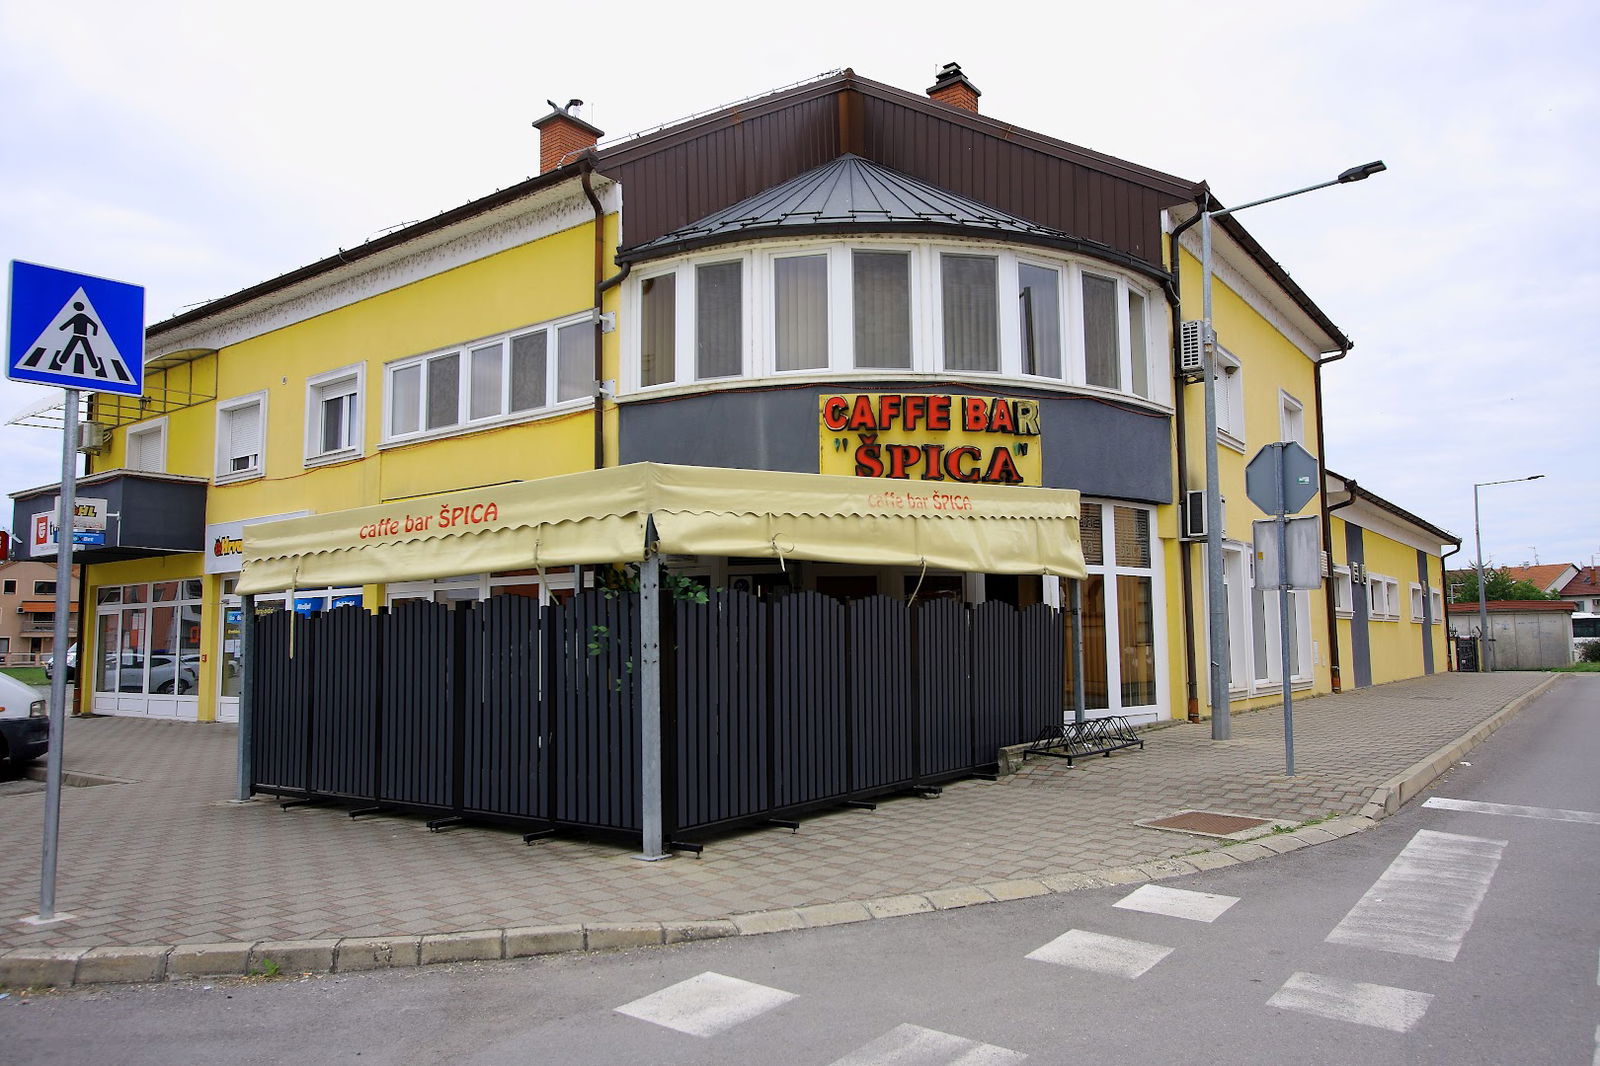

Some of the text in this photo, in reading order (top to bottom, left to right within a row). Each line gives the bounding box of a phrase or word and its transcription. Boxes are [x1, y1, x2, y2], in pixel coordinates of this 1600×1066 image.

[823, 395, 1040, 435] CAFFE BAR
[867, 490, 972, 510] caffe bar ŠPICA
[359, 502, 498, 540] caffe bar ŠPICA
